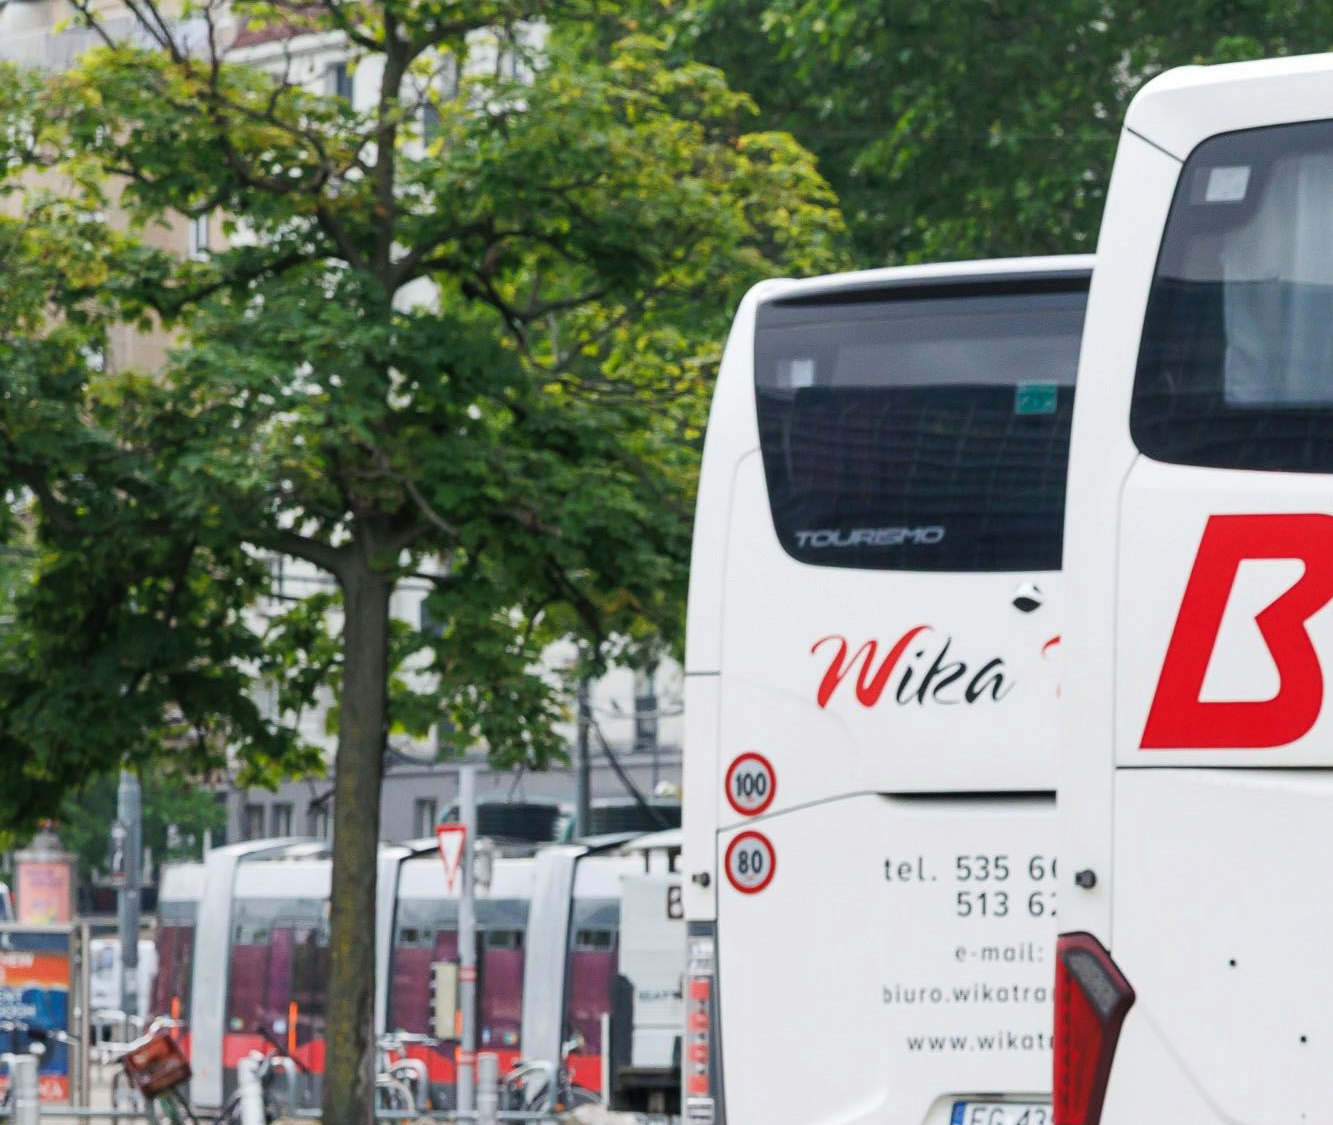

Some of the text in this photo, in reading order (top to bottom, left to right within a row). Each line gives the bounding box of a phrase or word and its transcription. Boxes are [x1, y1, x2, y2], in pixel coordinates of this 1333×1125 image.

[795, 525, 945, 548] TOURISMO
[810, 624, 1017, 709] Wika
[736, 772, 766, 797] 100
[738, 850, 762, 874] 80
[884, 856, 937, 881] tel.
[956, 855, 1009, 881] 535
[956, 891, 1009, 917] 513
[955, 942, 1043, 963] e-mail:
